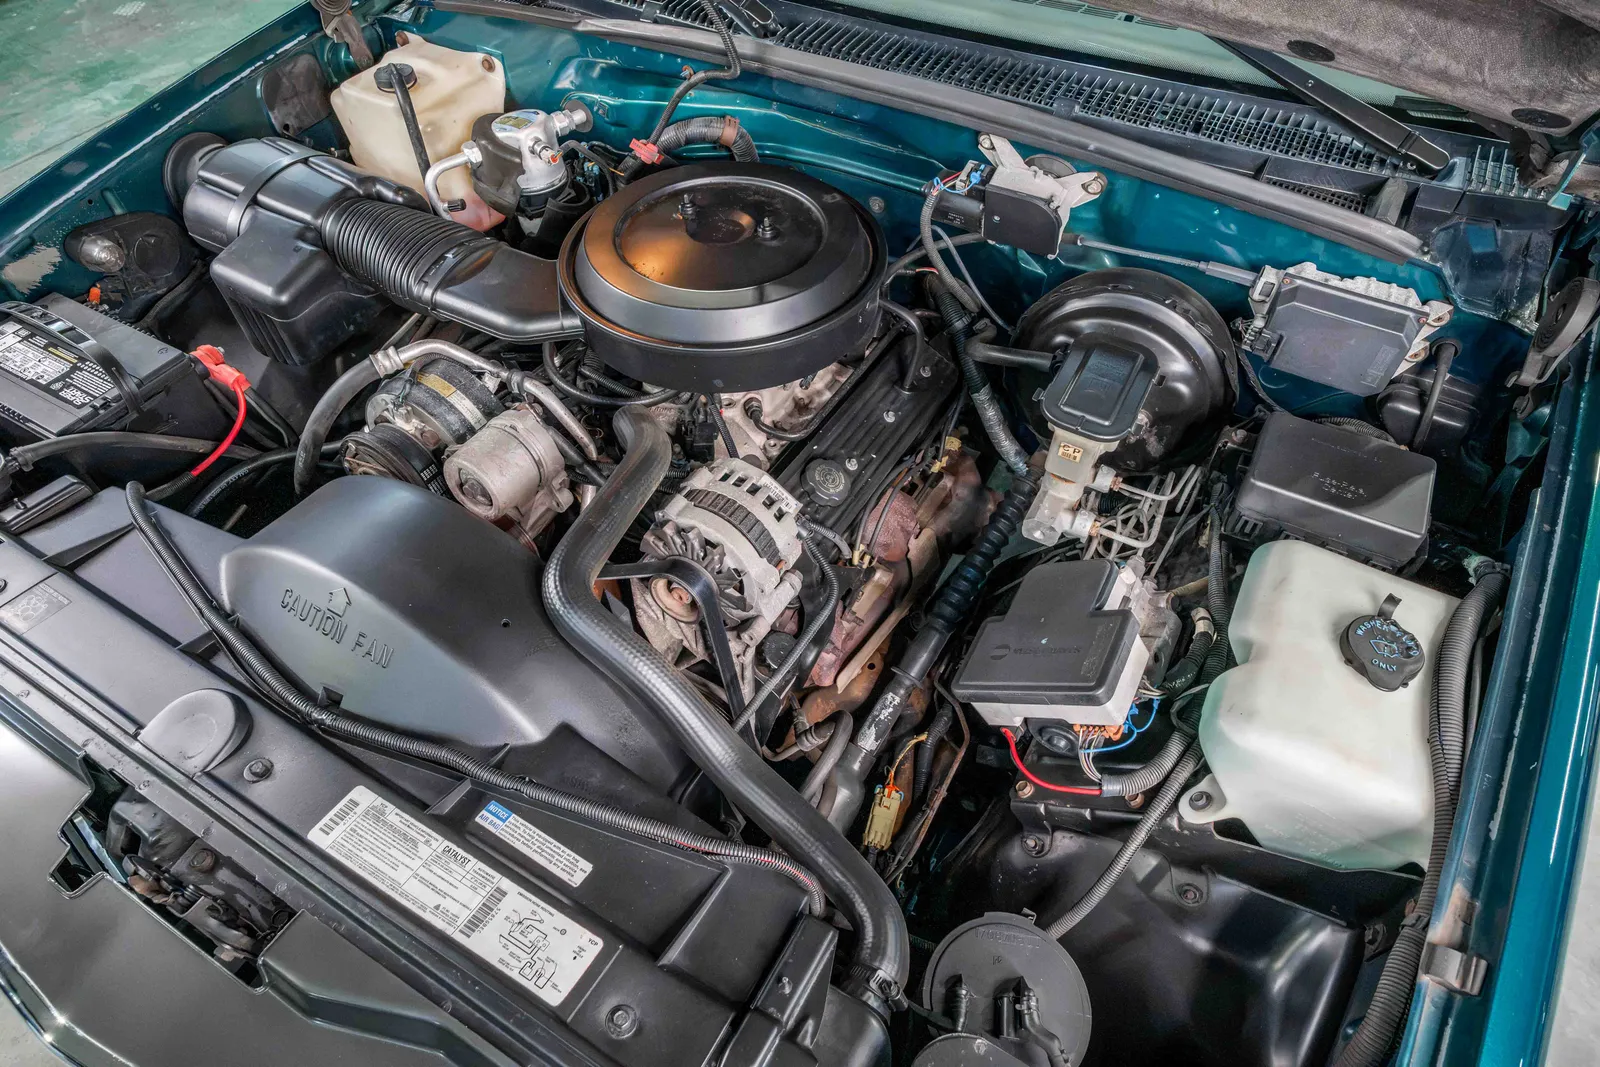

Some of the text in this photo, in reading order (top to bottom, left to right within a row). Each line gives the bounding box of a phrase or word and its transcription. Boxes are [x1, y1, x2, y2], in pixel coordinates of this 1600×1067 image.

[281, 588, 394, 668] CAUTION FAN
[1355, 620, 1390, 636] WASHER
[1372, 658, 1397, 671] ONLY
[487, 803, 509, 820] NOTICE
[478, 812, 500, 830] AIR BAG
[442, 844, 471, 866] CATALYST
[587, 937, 598, 947] YCP
